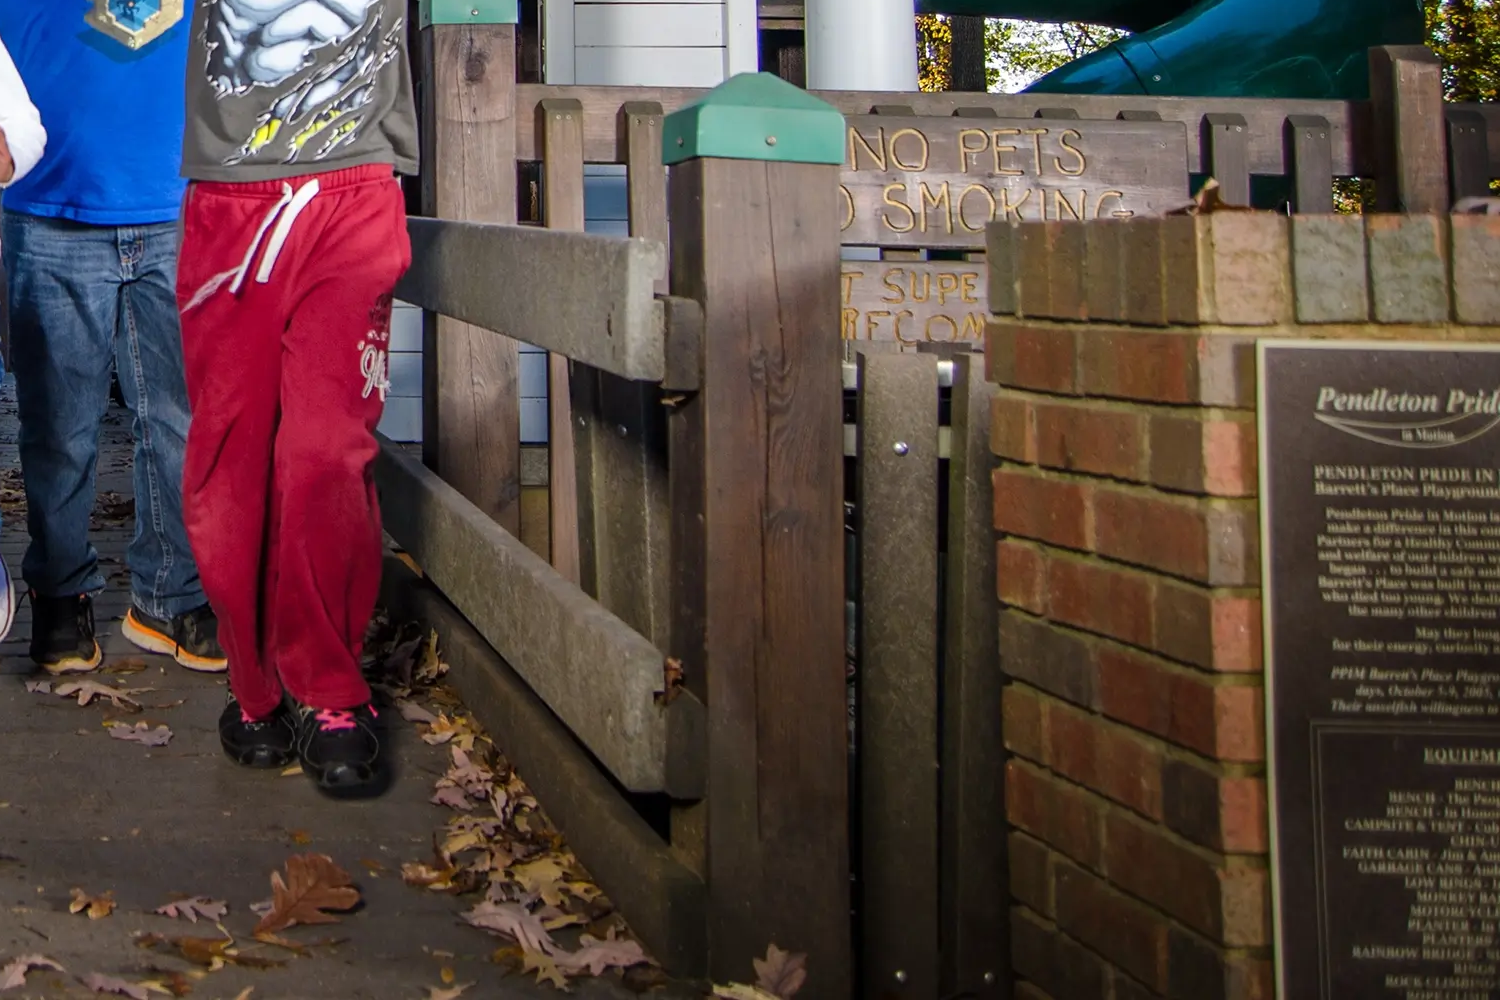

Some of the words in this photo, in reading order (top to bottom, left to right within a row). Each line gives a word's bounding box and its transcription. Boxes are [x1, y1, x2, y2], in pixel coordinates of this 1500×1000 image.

[848, 126, 930, 173] NO
[958, 127, 1087, 177] PETS
[1316, 387, 1438, 412] Pendleton
[1447, 389, 1500, 414] Prid
[1314, 465, 1415, 480] PENDLETON
[1420, 467, 1471, 481] PRIDE
[1475, 468, 1494, 482] IN
[1314, 481, 1378, 496] Barrett's
[1382, 482, 1420, 496] Place
[1326, 507, 1388, 520] Pendleton
[1391, 508, 1424, 521] Pride
[1442, 509, 1487, 522] Motion
[1327, 521, 1361, 533] make
[1373, 522, 1435, 535] difference
[1317, 534, 1370, 547] Partners
[1373, 535, 1392, 548] for
[1317, 548, 1342, 561] and
[1329, 562, 1366, 576] began
[1405, 562, 1437, 576] build
[1348, 604, 1368, 616] the
[1444, 605, 1496, 619] children
[1415, 626, 1440, 641] May
